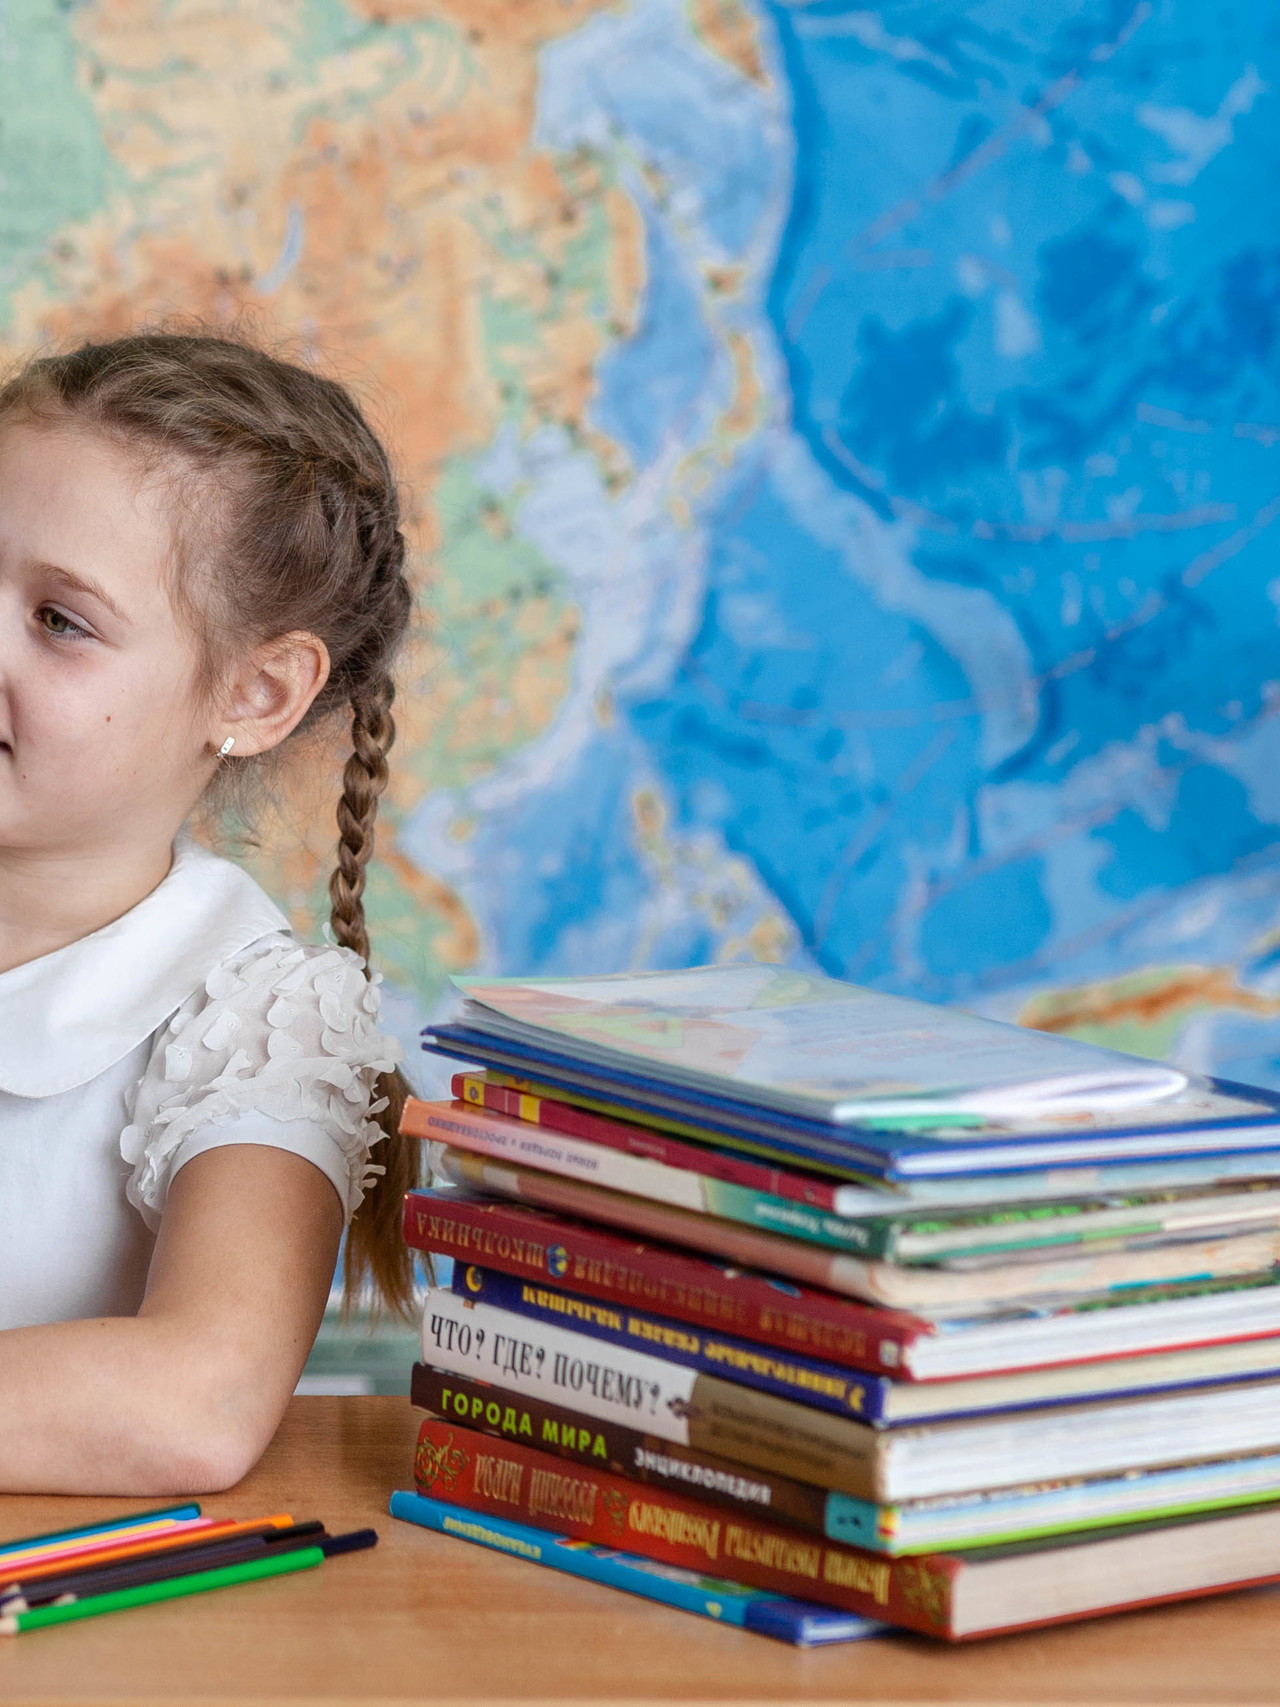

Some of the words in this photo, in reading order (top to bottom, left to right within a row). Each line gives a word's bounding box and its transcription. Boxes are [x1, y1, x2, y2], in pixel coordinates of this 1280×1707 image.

[417, 1211, 545, 1268] ШКОЛЬНИКА
[522, 1285, 622, 1331] малышам
[431, 1314, 486, 1360] ЧТО?
[493, 1333, 546, 1381] ГДЕ?
[552, 1352, 661, 1415] ПОЧЕМУ?
[441, 1388, 533, 1437] ГОРОДА
[542, 1418, 608, 1459] МИРА
[634, 1447, 772, 1506] ЭНЦИКЛОПЕДИЯ
[472, 1452, 524, 1506] НАРОД
